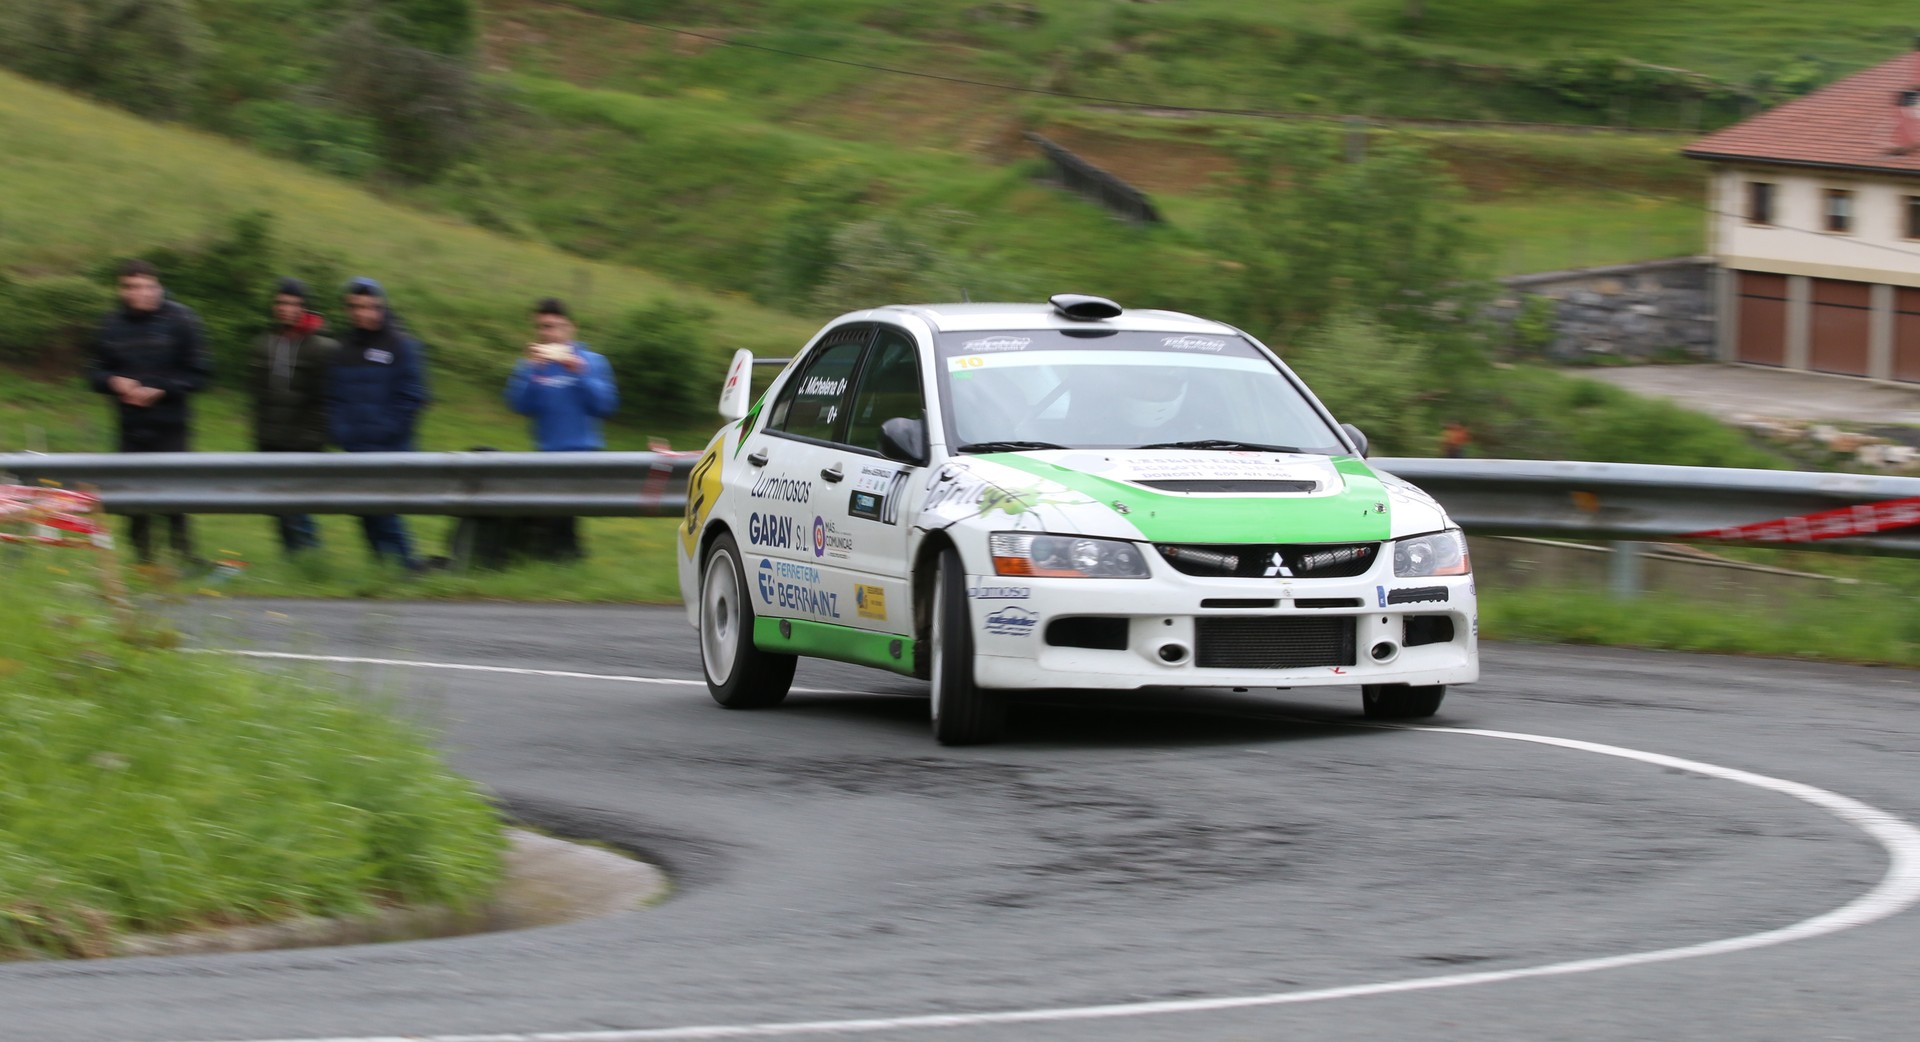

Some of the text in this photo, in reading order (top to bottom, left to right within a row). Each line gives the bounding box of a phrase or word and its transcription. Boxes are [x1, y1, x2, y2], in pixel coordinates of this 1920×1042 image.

[955, 357, 984, 369] 10
[805, 376, 838, 396] Michelena
[751, 471, 812, 504] Luminosos
[1142, 471, 1203, 479] DONOSTI
[749, 512, 792, 549] GARAY
[777, 582, 840, 619] BERRIAINZ
